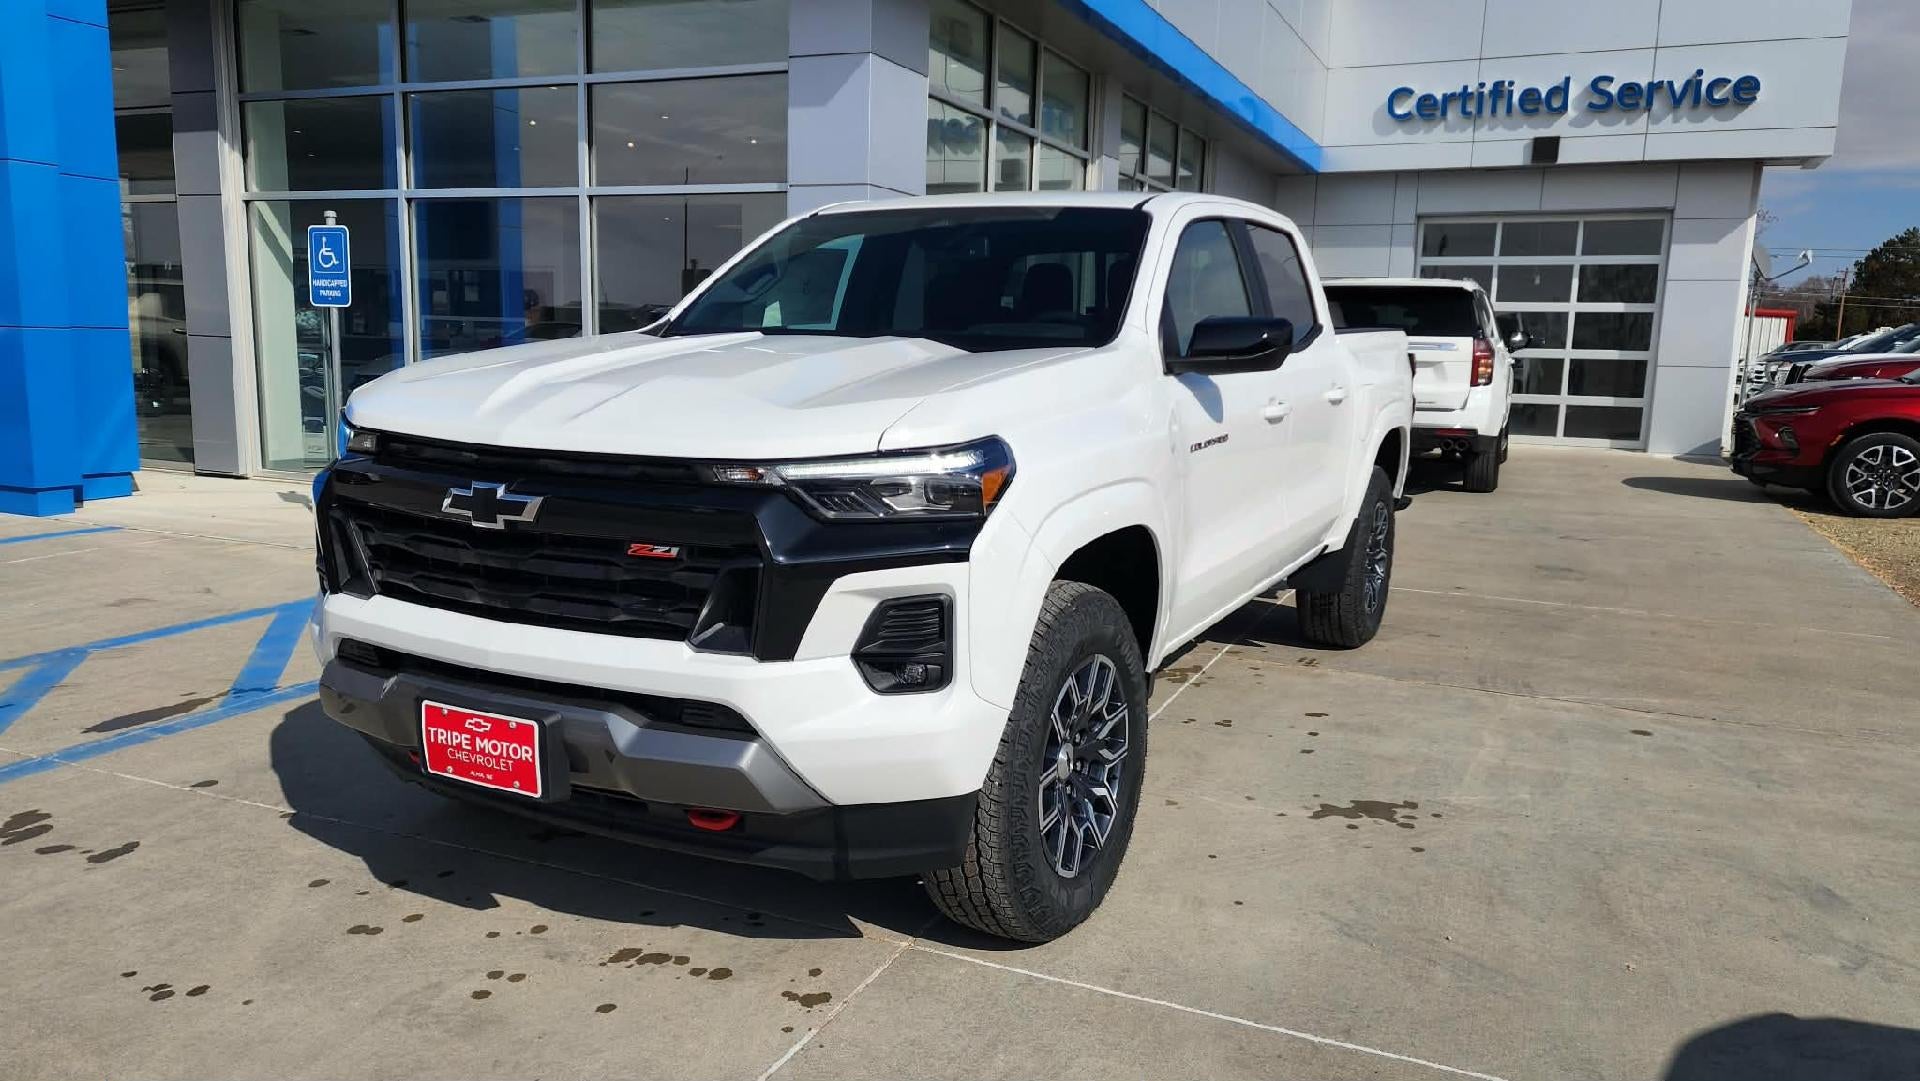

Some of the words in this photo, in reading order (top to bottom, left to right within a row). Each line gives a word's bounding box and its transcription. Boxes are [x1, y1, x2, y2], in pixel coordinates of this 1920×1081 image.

[1387, 76, 1571, 121] Certified
[1587, 68, 1761, 113] Service
[319, 289, 342, 297] PARKING
[627, 543, 680, 559] Z71
[427, 726, 472, 751] TRIPE
[475, 736, 533, 763] MOTOR
[447, 747, 514, 772] CHEVROLET
